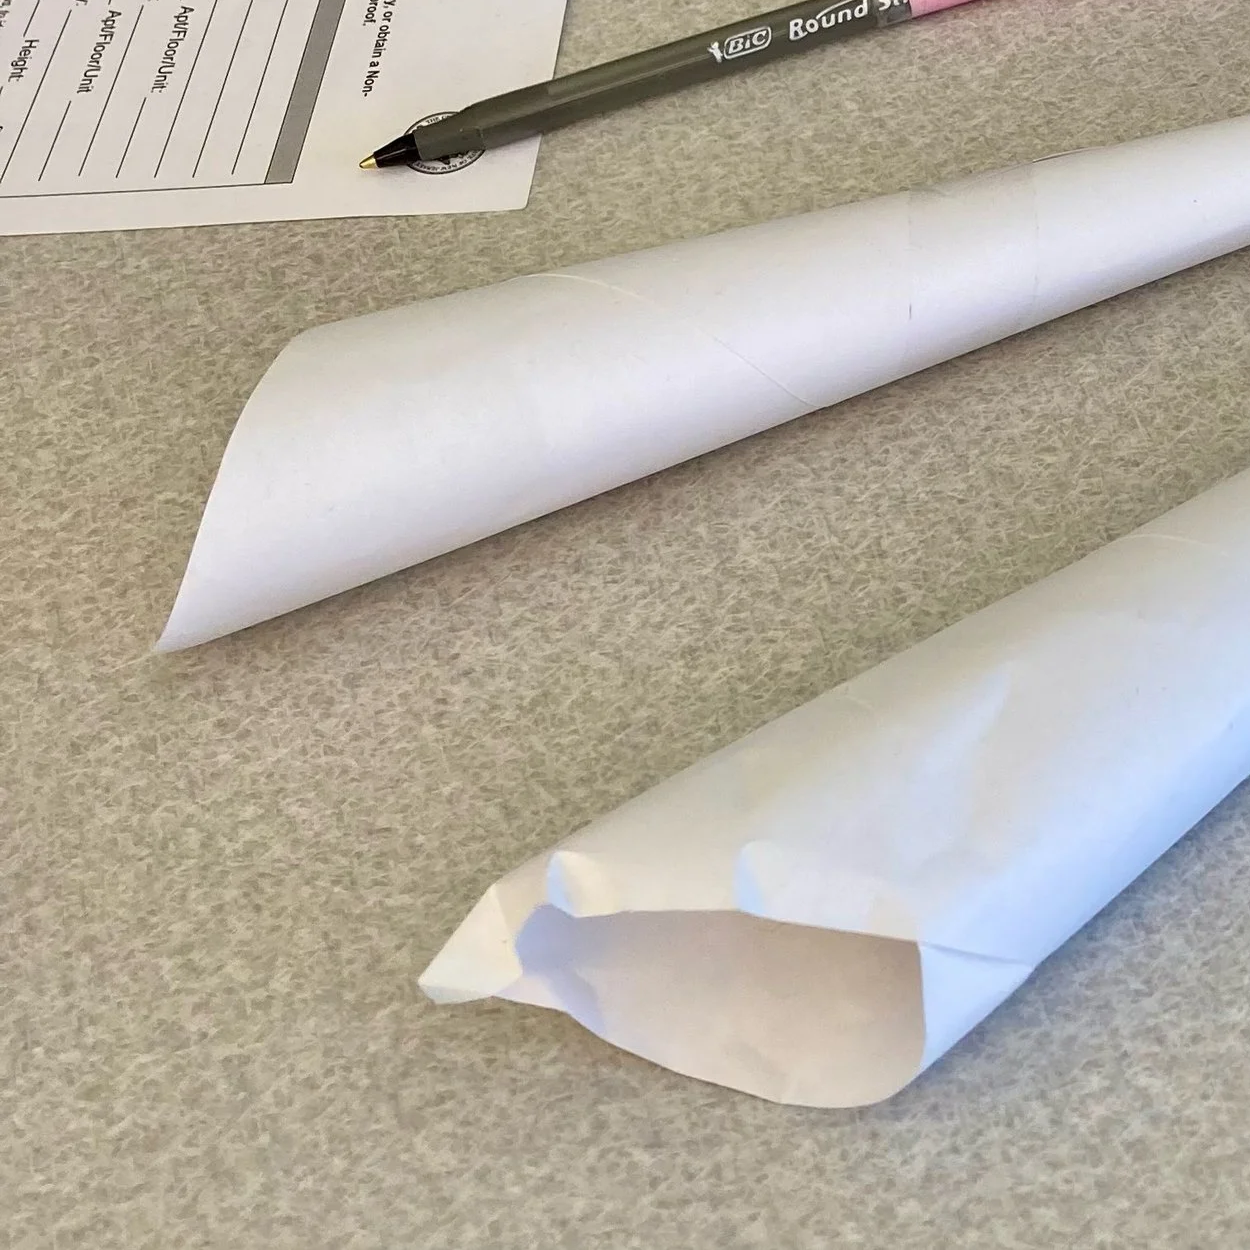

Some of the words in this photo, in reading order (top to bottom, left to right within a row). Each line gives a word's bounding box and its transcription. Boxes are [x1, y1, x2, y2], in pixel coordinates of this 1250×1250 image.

[382, 10, 392, 22] or
[789, 0, 867, 41] Round
[76, 10, 122, 94] Apt/Floor/Unit
[152, 6, 194, 92] Apt/Floor/Unit:
[372, 24, 390, 58] obtain
[8, 40, 40, 82] Height:
[370, 60, 380, 68] a
[362, 70, 380, 96] Non-
